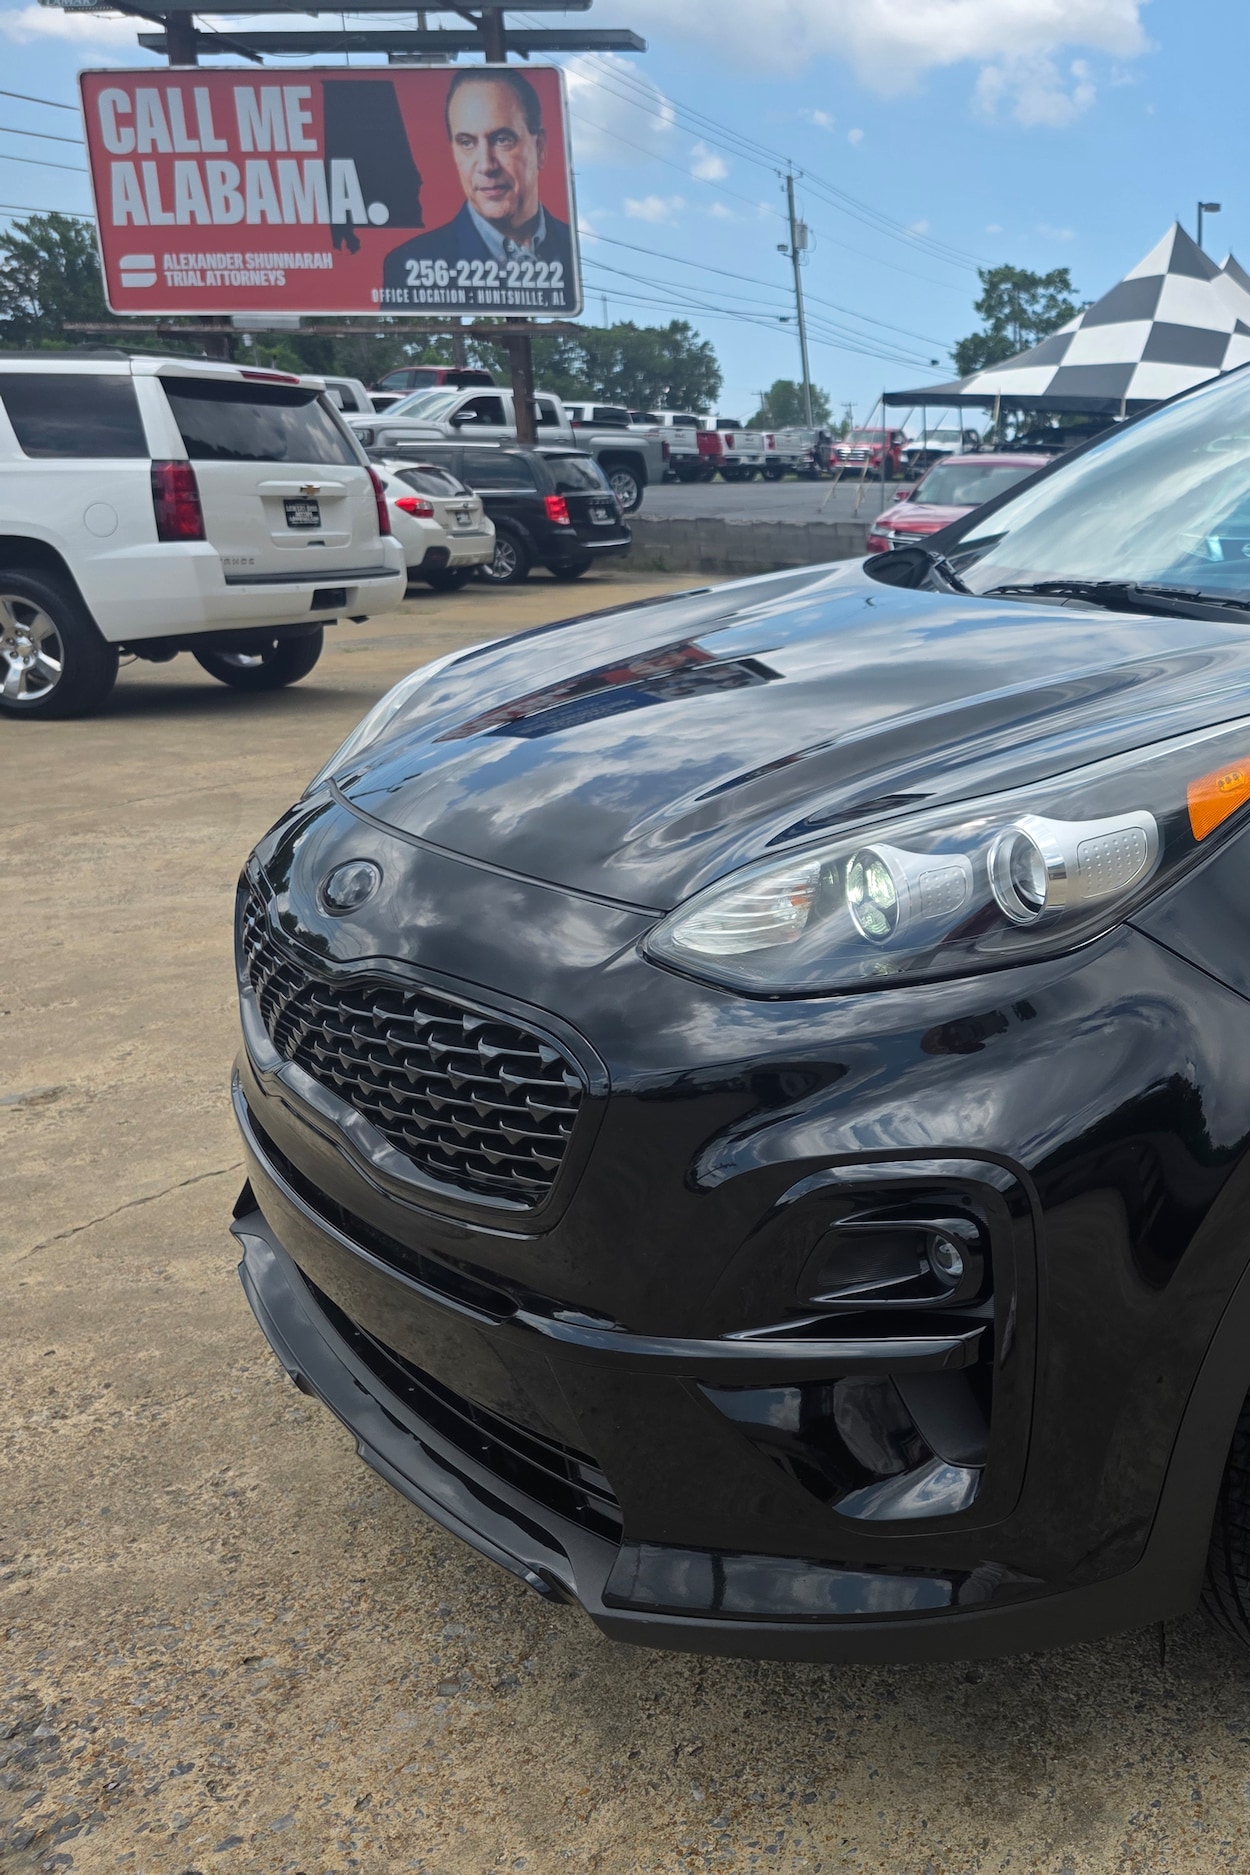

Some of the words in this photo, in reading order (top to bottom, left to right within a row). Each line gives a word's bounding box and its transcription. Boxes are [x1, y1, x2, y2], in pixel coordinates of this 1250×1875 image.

[98, 86, 228, 155] CALL
[234, 85, 318, 153] ME
[110, 157, 390, 227] ALABAMA.
[163, 252, 244, 270] ALEXANDER
[246, 252, 334, 270] SHUNNARAH
[164, 270, 206, 287] TRIAL
[206, 270, 287, 287] ATTORNEYS
[405, 259, 566, 289] 256-222-2222
[371, 287, 410, 303] OFFICE
[413, 288, 466, 304] LOCATION
[477, 289, 549, 307] HUNTSVILLE,
[552, 290, 567, 306] AL
